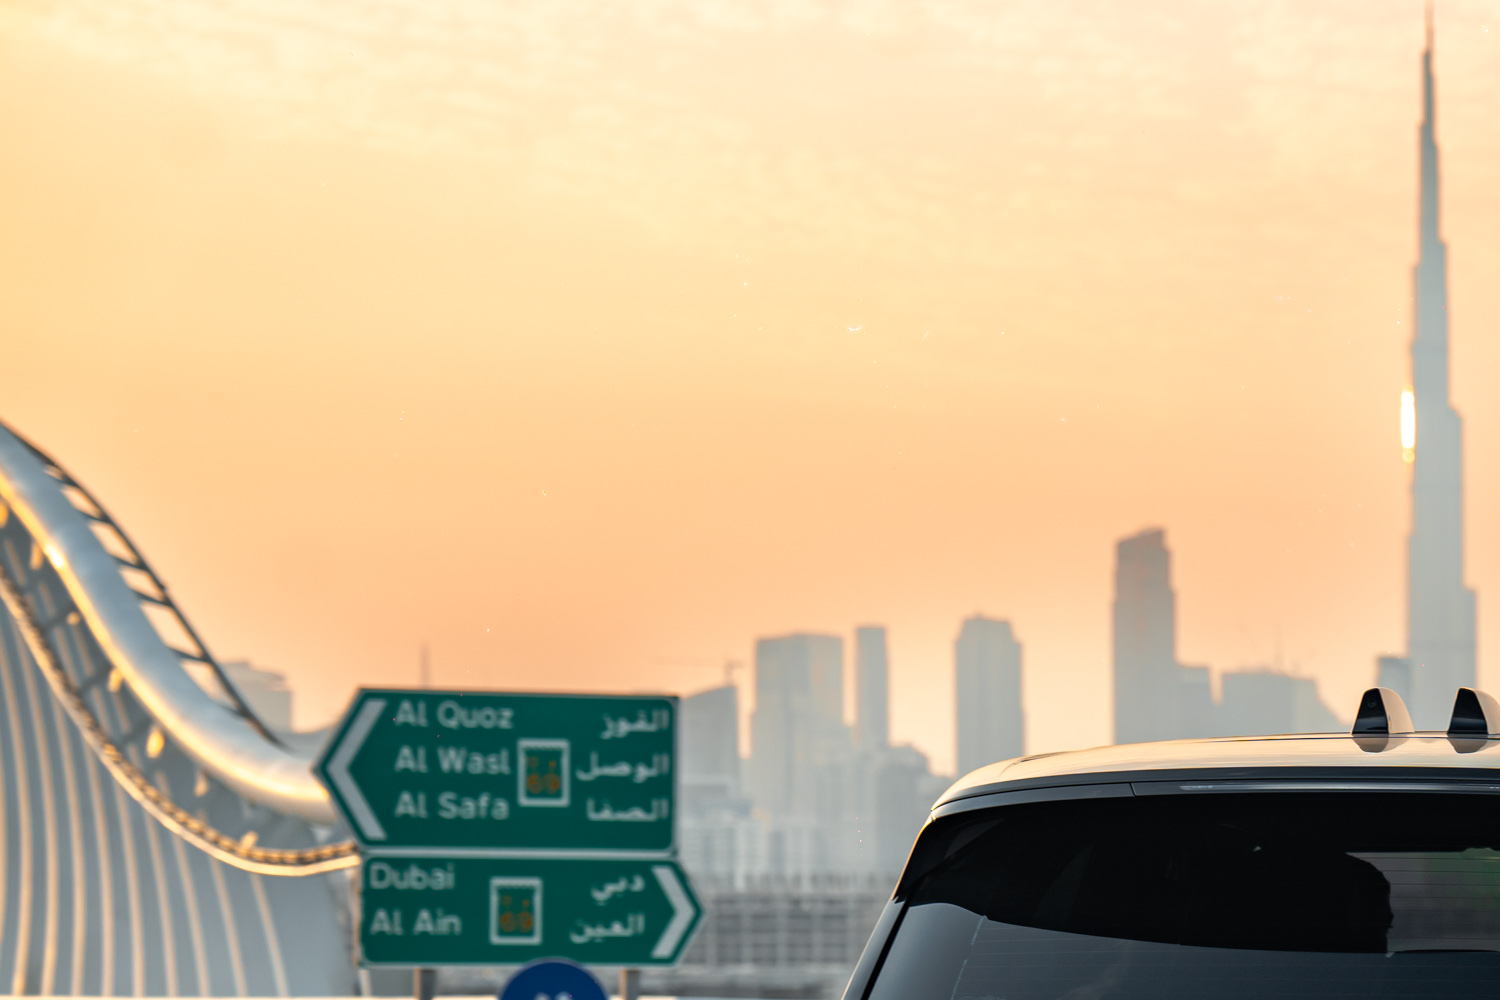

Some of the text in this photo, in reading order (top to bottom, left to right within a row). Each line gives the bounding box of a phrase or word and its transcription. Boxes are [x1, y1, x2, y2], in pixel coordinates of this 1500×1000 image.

[395, 701, 514, 729] Al Quoz
[601, 710, 669, 739] القوز
[395, 747, 427, 773] Al
[438, 748, 510, 775] Wasl
[576, 752, 669, 782] الوصل
[395, 792, 510, 820] Al Safa
[587, 797, 669, 821] الصفا
[370, 863, 455, 889] Dubai
[592, 874, 645, 904] دبي
[370, 910, 462, 935] Al Ain
[570, 914, 645, 944] العين
